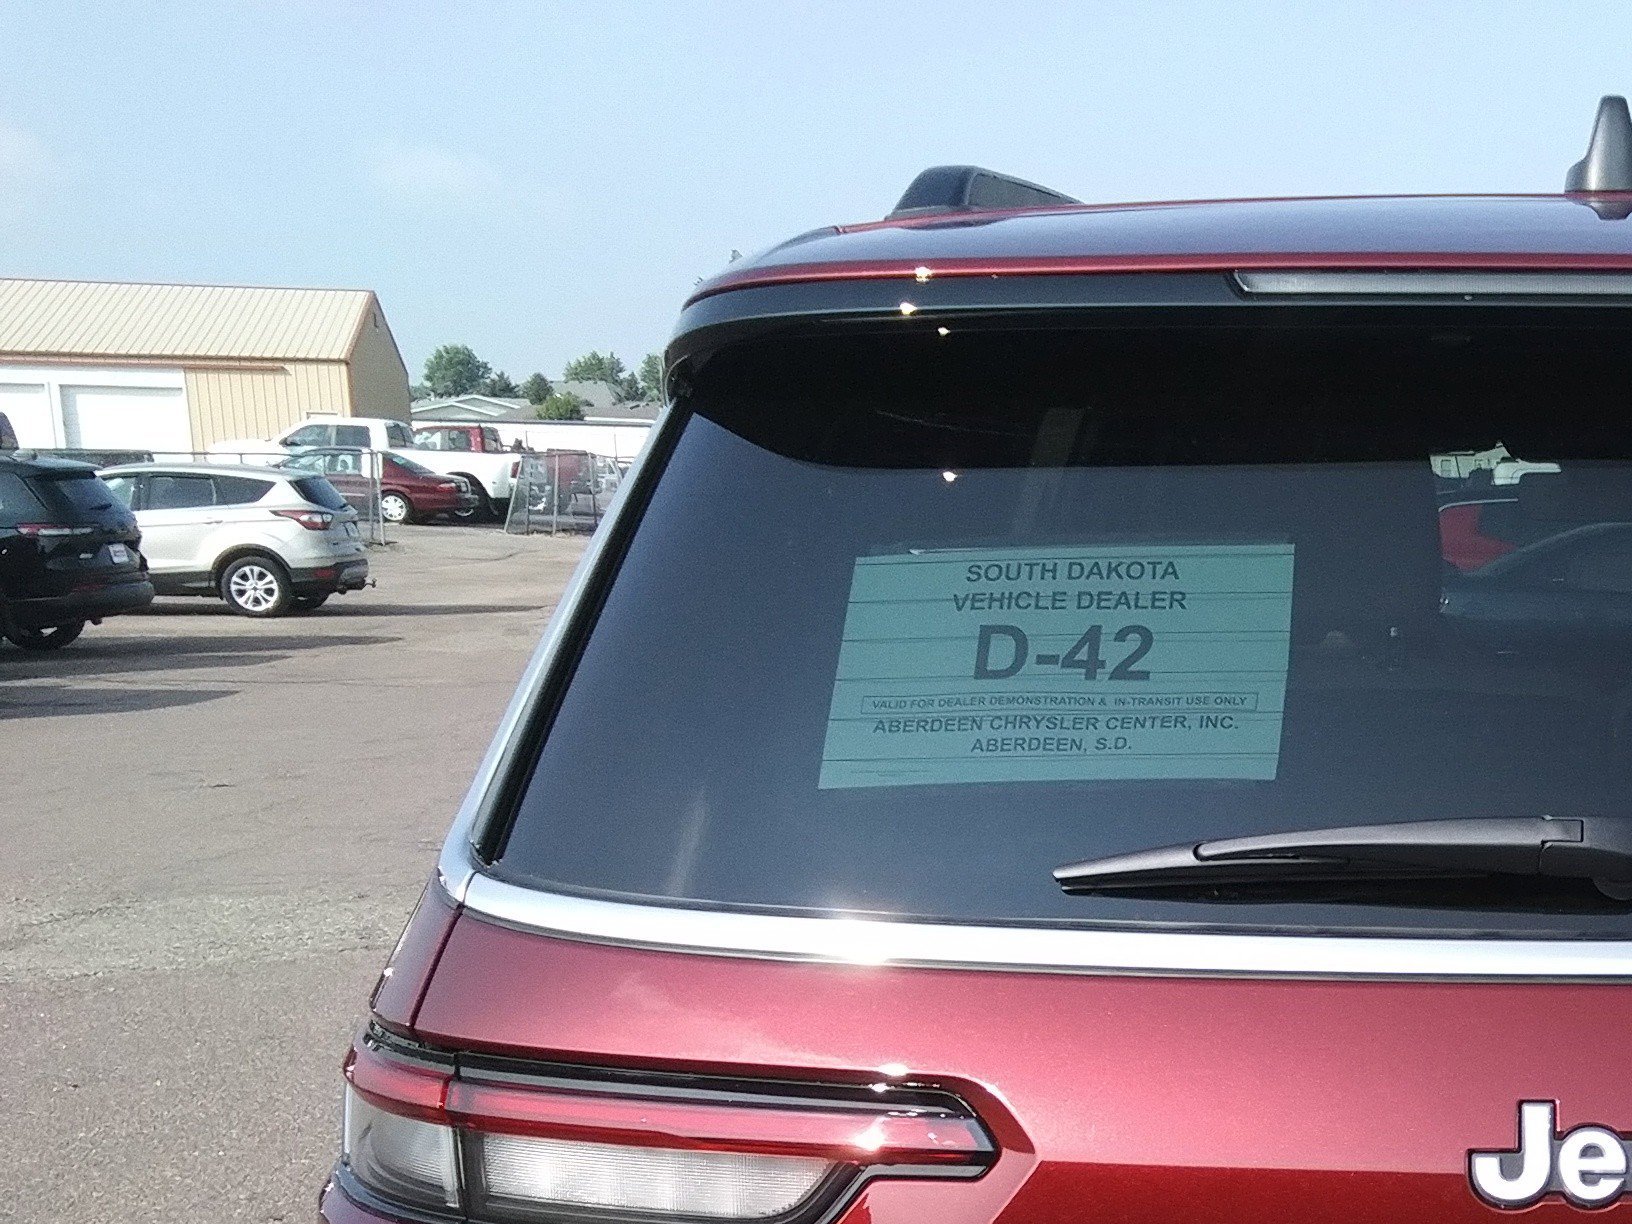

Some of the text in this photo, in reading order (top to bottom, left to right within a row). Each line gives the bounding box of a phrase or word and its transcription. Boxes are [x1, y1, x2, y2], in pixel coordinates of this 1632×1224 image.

[966, 560, 1180, 583] SOUTH DAKOTA
[953, 590, 1187, 612] VEHICLE DEALER
[973, 624, 1155, 681] D-42
[872, 699, 907, 709] VALID
[910, 699, 935, 708] FOR
[938, 697, 986, 708] DEALER
[989, 696, 1095, 706] DEMONSTRATION
[1114, 697, 1182, 706] IN-TRANSIT
[1186, 697, 1210, 706] USE
[1214, 696, 1248, 706] ONLY
[872, 715, 1240, 733] ABERDEEN CHRYSLER CENTER, INC.
[970, 737, 1133, 753] ABERDEEN, S.D.
